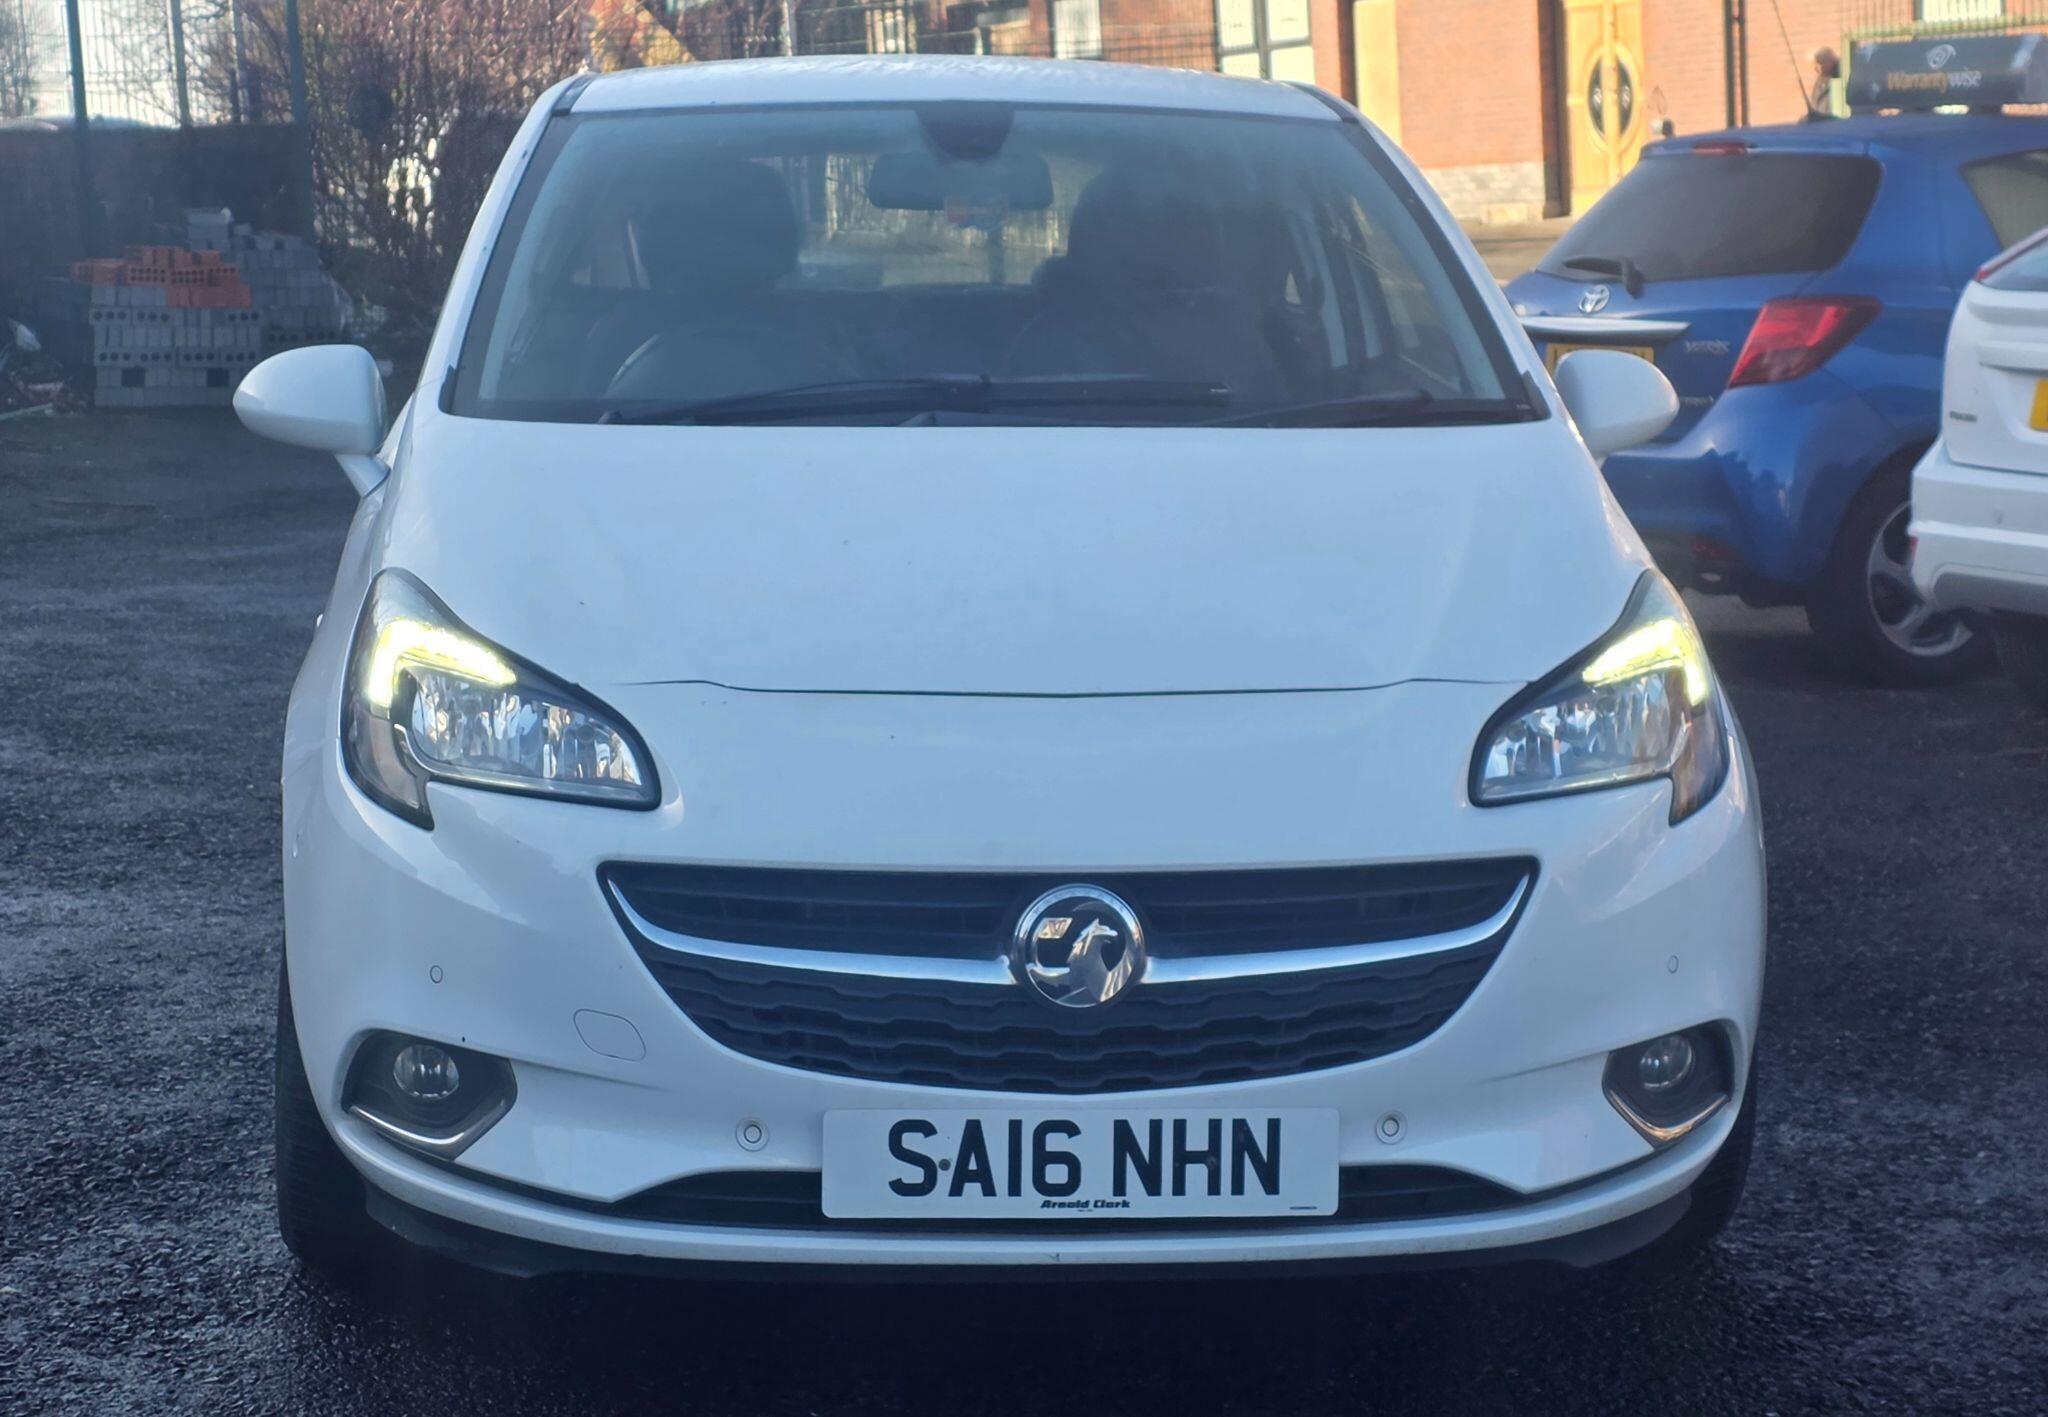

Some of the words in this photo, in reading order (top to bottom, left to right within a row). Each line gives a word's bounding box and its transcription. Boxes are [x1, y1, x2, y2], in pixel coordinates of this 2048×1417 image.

[888, 1119, 1082, 1197] SA16
[1112, 1118, 1281, 1197] NHN
[1040, 1199, 1090, 1209] Arnold
[1093, 1199, 1130, 1209] Clark
